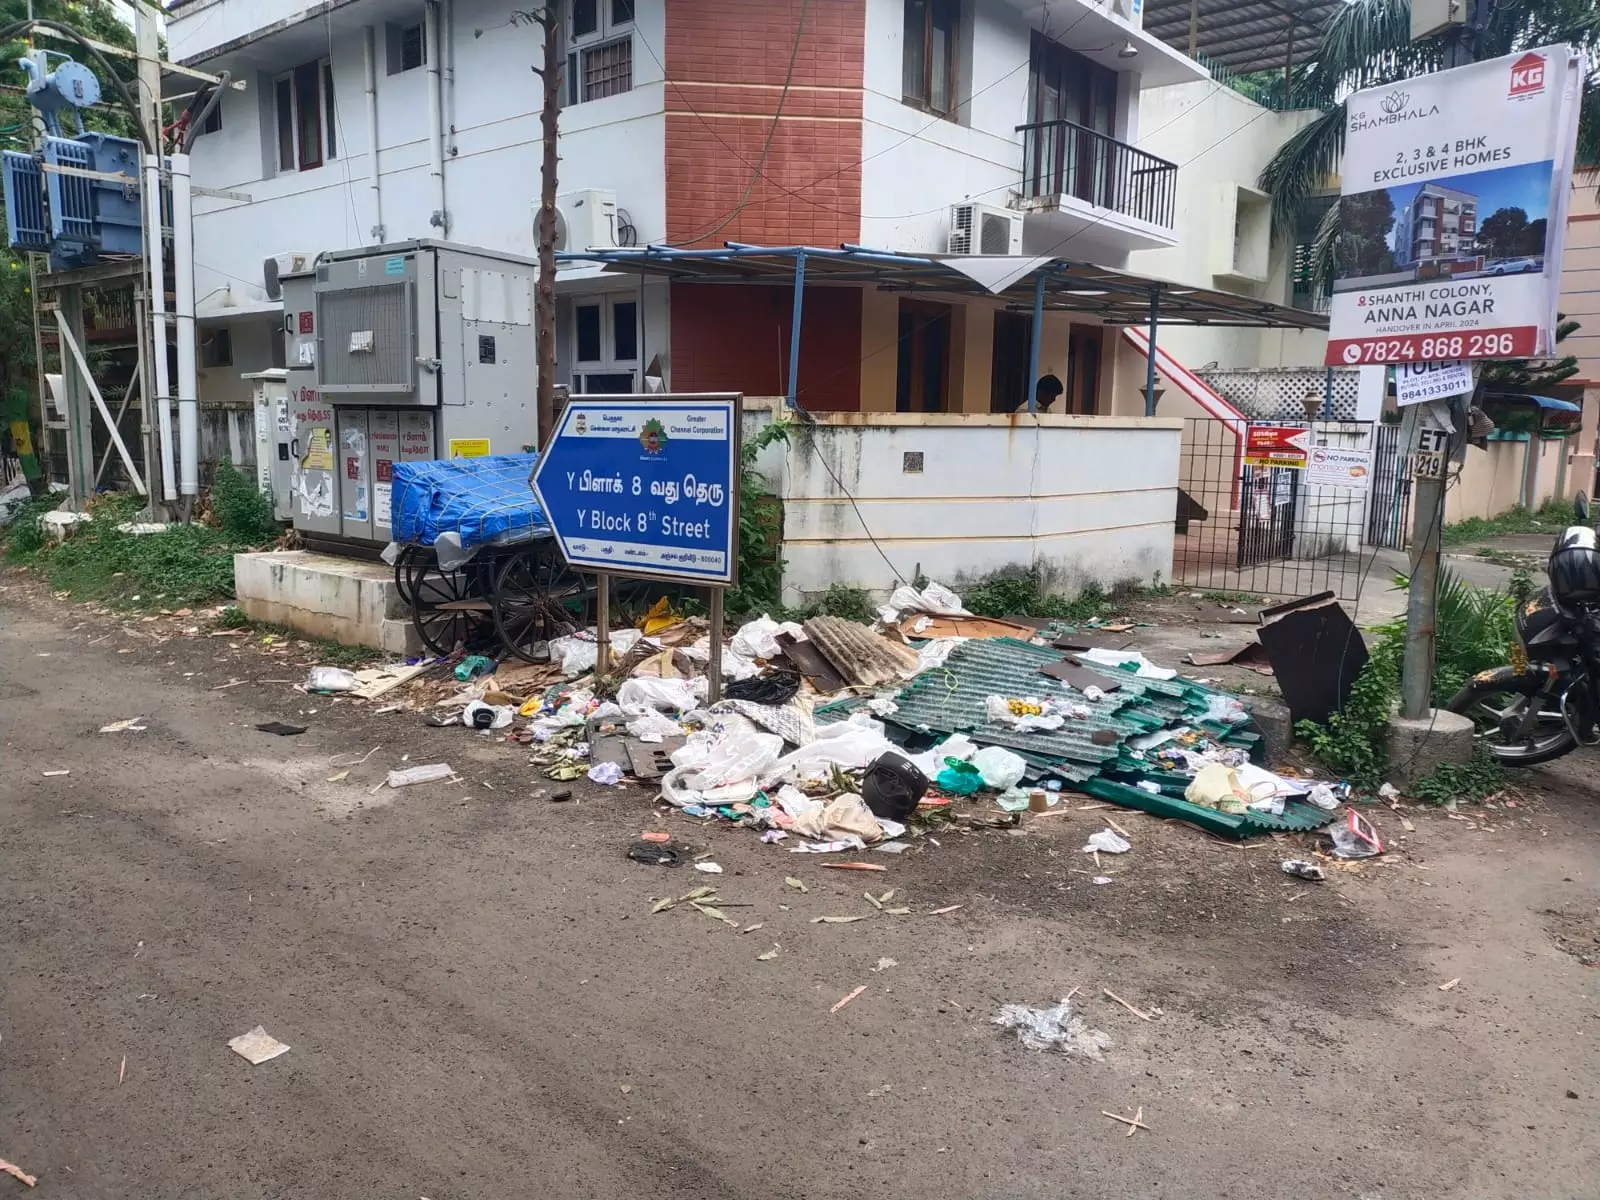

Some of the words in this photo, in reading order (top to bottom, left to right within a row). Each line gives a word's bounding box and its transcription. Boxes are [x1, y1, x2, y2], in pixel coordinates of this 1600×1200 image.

[1512, 67, 1543, 89] KG
[1350, 111, 1366, 121] KG
[1350, 104, 1440, 133] SHAMBHALA
[1396, 152, 1408, 164] 2,
[1413, 149, 1420, 160] 3
[1426, 146, 1436, 158] &
[1441, 143, 1449, 155] 4
[1455, 136, 1487, 153] BHK
[1373, 158, 1449, 183] EXCLUSIVE
[1454, 147, 1512, 168] HOMES
[1368, 290, 1425, 306] SHANTHI
[1430, 284, 1493, 300] COLONY,
[1364, 306, 1417, 323] ANNA
[1425, 299, 1494, 318] NAGAR
[1376, 324, 1421, 334] HANDOVER
[1434, 320, 1456, 329] APRIL
[1459, 319, 1479, 328] 2024
[1363, 340, 1415, 362] 7824
[1421, 336, 1463, 359] 868
[1468, 333, 1513, 356] 296
[1401, 379, 1466, 401] 9841333011
[687, 414, 706, 423] Greater
[670, 426, 691, 434] Chennai
[692, 426, 724, 435] Corporation
[1419, 429, 1447, 452] ET
[1270, 459, 1299, 467] PARKING
[566, 471, 575, 491] Y
[579, 469, 623, 494] பிளாக்
[631, 475, 642, 496] 8
[650, 480, 680, 504] வது
[683, 473, 724, 507] தெரு
[577, 508, 586, 528] Y
[591, 509, 631, 532] Block
[637, 510, 657, 532] 8th
[661, 515, 711, 539] Street
